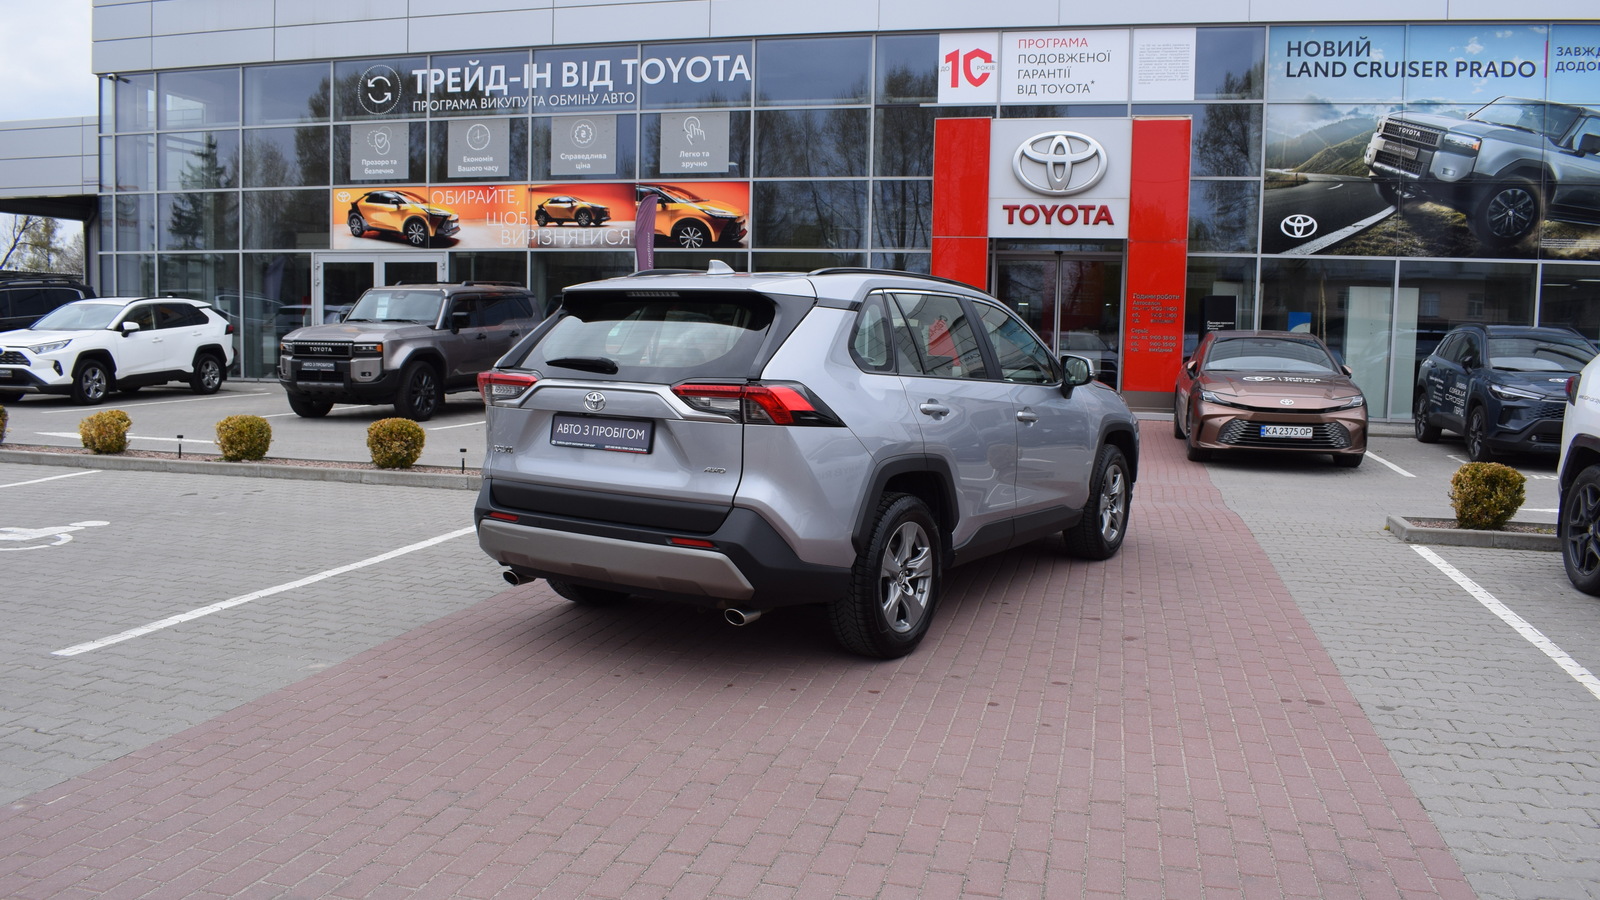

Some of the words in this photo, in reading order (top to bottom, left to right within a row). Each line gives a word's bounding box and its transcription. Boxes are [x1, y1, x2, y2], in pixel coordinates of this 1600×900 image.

[1017, 38, 1088, 49] ПРОГРАМА
[1286, 36, 1372, 57] НОВИЙ
[1017, 50, 1112, 65] ПОДОВЖЕНОЇ
[1017, 66, 1072, 79] ГАРАНТІЇ
[1286, 61, 1347, 78] LAND
[1353, 60, 1449, 78] CRUISER
[1455, 60, 1537, 78] PRADO
[1555, 61, 1600, 73] ДОДО
[412, 60, 552, 96] ТРЕЙД-ІН
[562, 60, 614, 92] ВІД
[621, 54, 752, 85] TOYOTA
[1017, 85, 1038, 96] ВІД
[413, 99, 478, 112] ПРОГРАМА
[481, 96, 529, 109] ВИКУПУ
[532, 96, 546, 107] ТА
[549, 94, 599, 106] ОБМІНУ
[602, 92, 635, 104] АВТО
[1398, 127, 1421, 137] TOYOTA
[463, 155, 493, 163] Економія
[560, 153, 607, 161] Справедлива
[679, 151, 701, 159] Легко
[361, 159, 389, 167] Прозоро
[483, 165, 499, 173] часу
[575, 162, 591, 170] ціна
[681, 161, 708, 169] зручно
[431, 187, 520, 206] ОБИРАЙТЕ,
[486, 211, 528, 227] ЩОБ
[1002, 204, 1115, 225] TOYOTA
[501, 228, 631, 246] ВИРІЗНЯТИСЯ
[1445, 393, 1465, 407] CROSS
[556, 423, 581, 435] АВТО
[583, 425, 590, 436] З
[591, 426, 645, 440] ПРОБІГОМ
[1265, 426, 1277, 435] KA
[1279, 426, 1299, 436] 2375
[1300, 426, 1312, 436] OP
